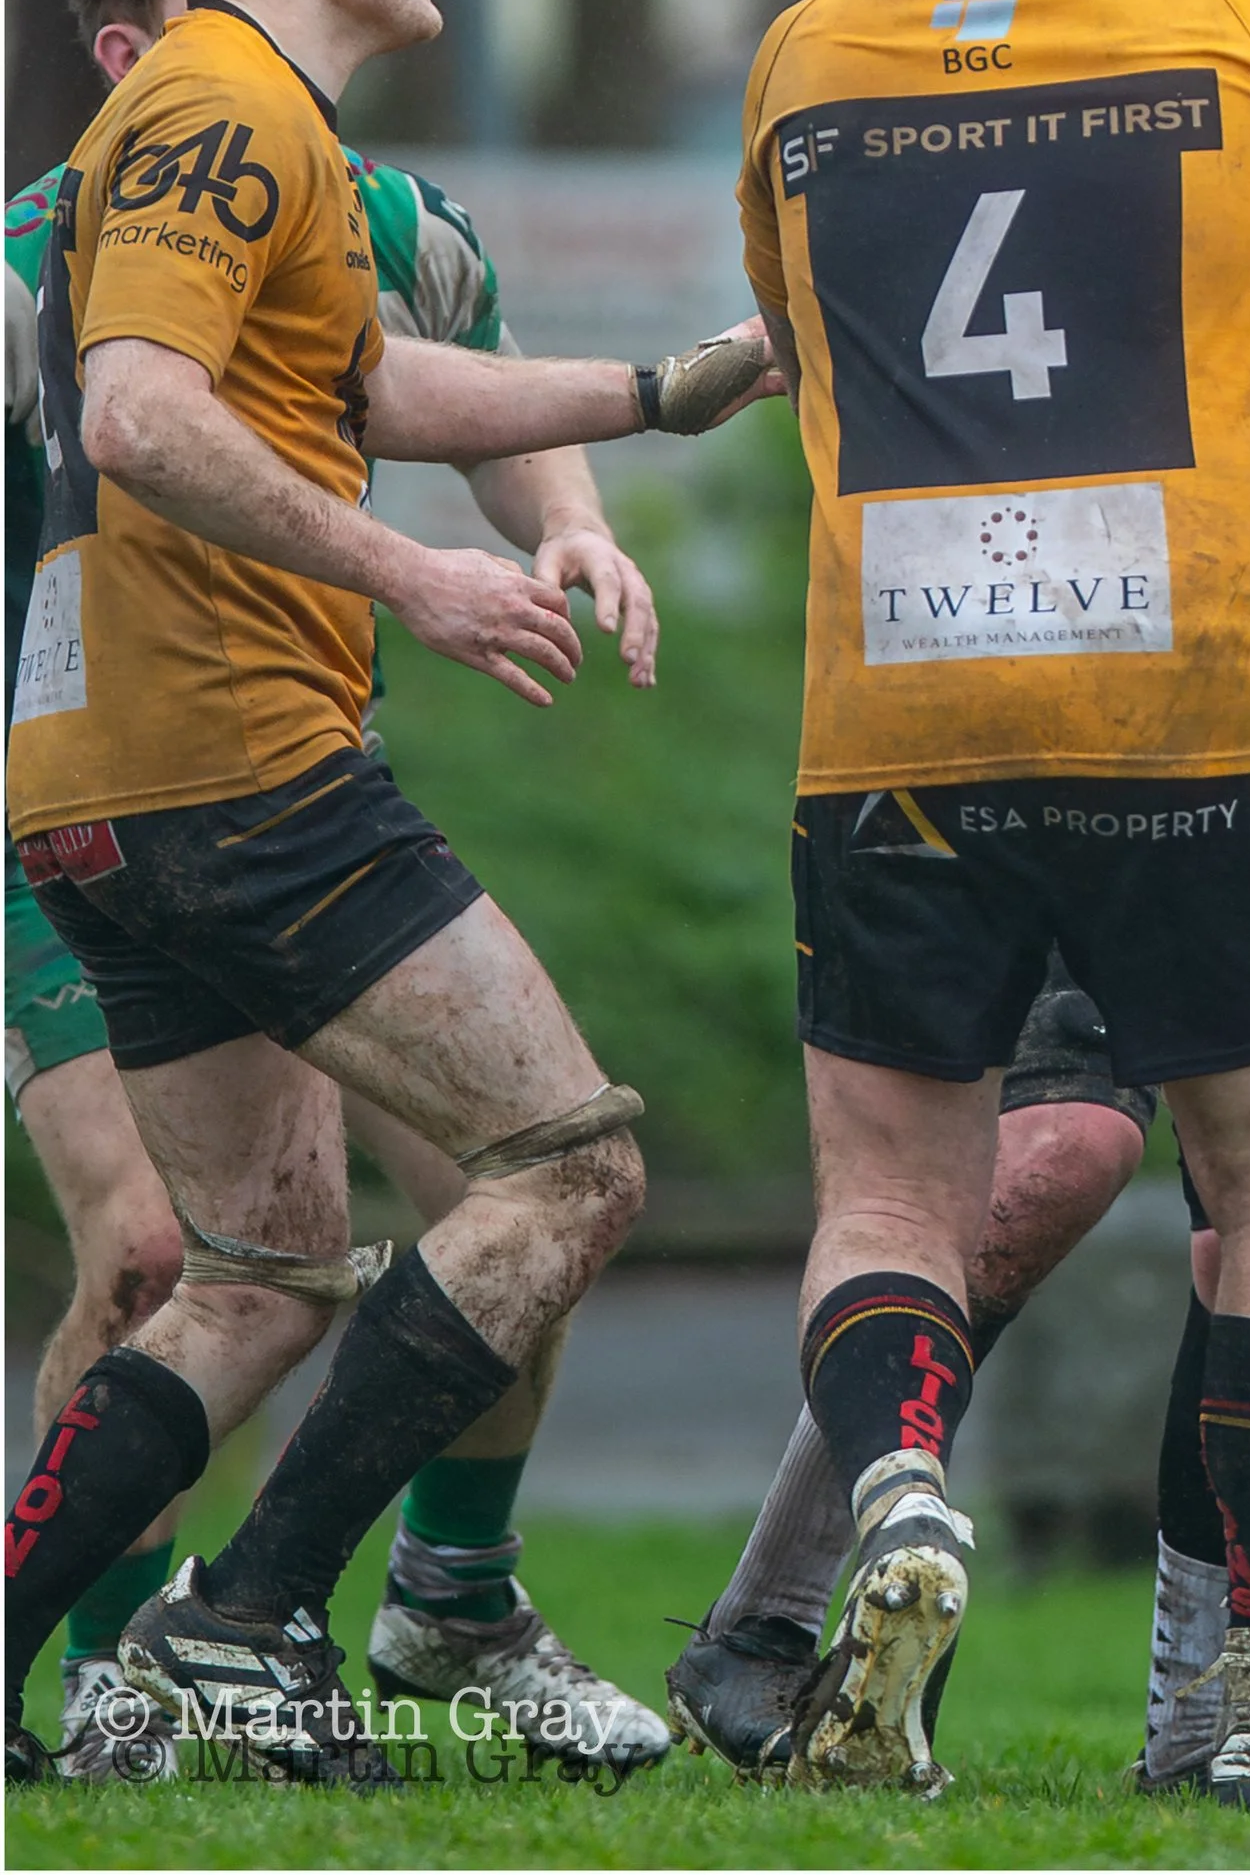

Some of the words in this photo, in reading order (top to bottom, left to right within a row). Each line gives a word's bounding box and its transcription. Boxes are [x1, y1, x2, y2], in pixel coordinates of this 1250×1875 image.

[943, 44, 1013, 74] BGC
[863, 118, 1012, 157] SPORT
[1027, 112, 1066, 143] IT
[1082, 99, 1209, 138] FIRST
[100, 221, 249, 294] marketing
[921, 189, 1068, 401] 4
[878, 575, 1151, 623] TWELVE
[902, 634, 978, 651] WEALTH
[986, 627, 1125, 645] MANAGEMENT
[959, 805, 1028, 832] ESA
[1042, 799, 1239, 840] PROPERTY
